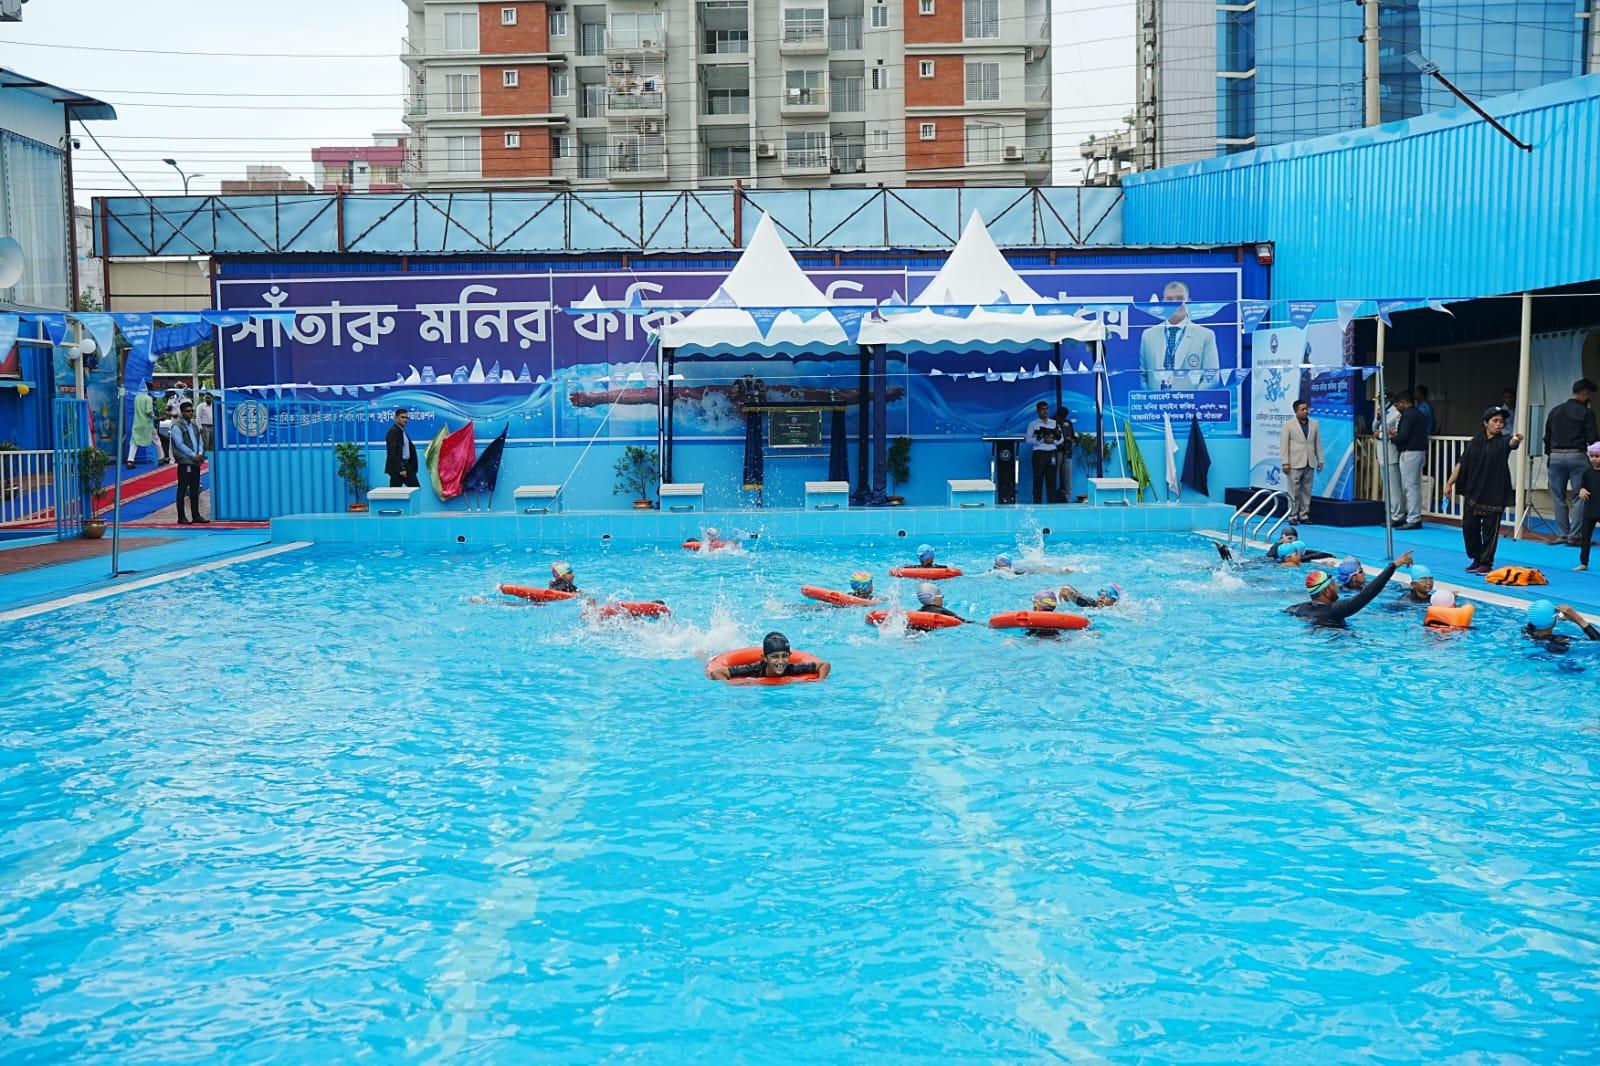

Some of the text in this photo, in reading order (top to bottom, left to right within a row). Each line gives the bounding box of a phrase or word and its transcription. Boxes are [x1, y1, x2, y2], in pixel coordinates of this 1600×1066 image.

[231, 282, 708, 353] সাঁতারু মনির ফকি
